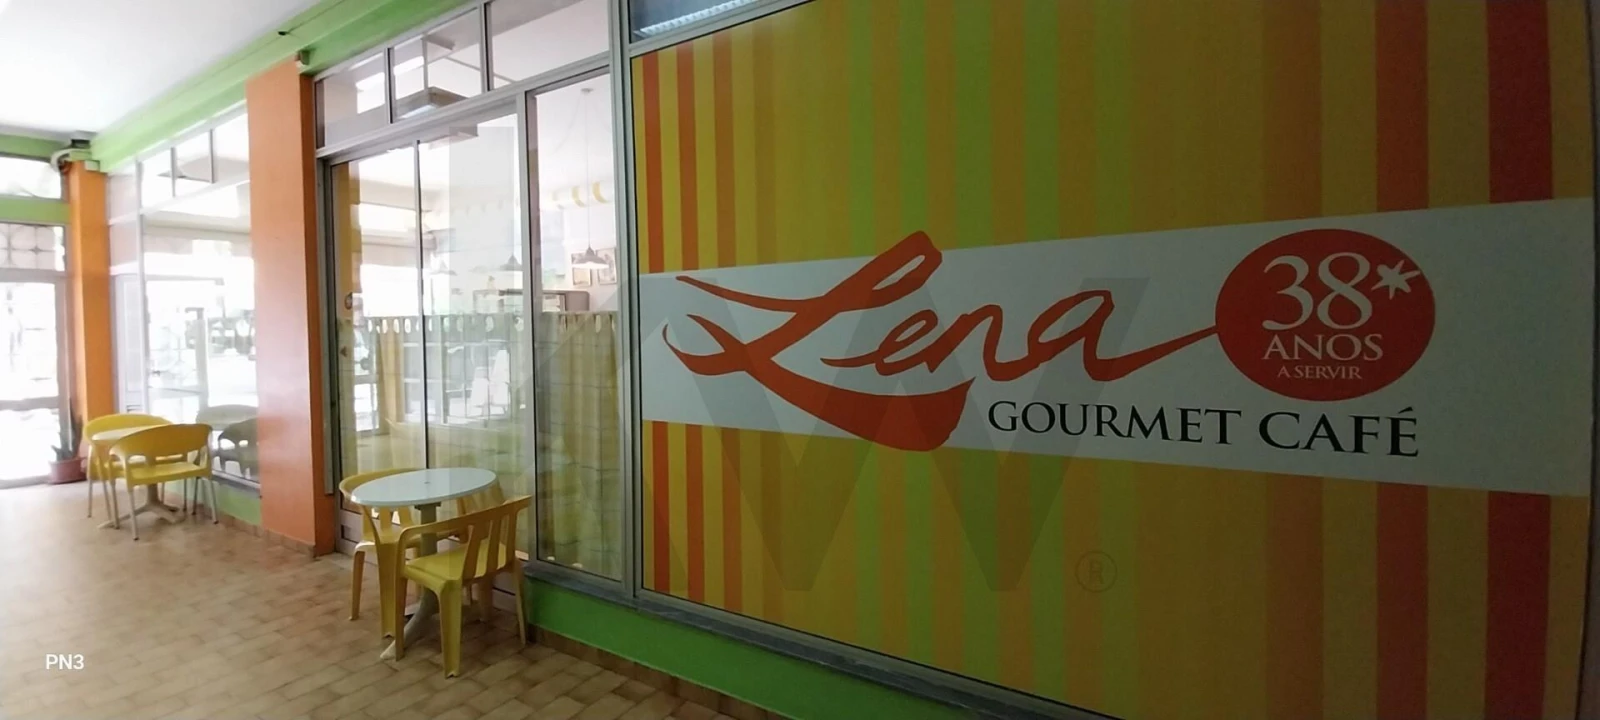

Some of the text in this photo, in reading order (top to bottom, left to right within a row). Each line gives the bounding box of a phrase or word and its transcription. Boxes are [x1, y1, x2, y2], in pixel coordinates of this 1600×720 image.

[662, 230, 1218, 452] Lena
[1261, 333, 1384, 362] ANOS
[1277, 365, 1363, 380] A SERVIR
[988, 400, 1420, 457] GOURMET CAFÉ
